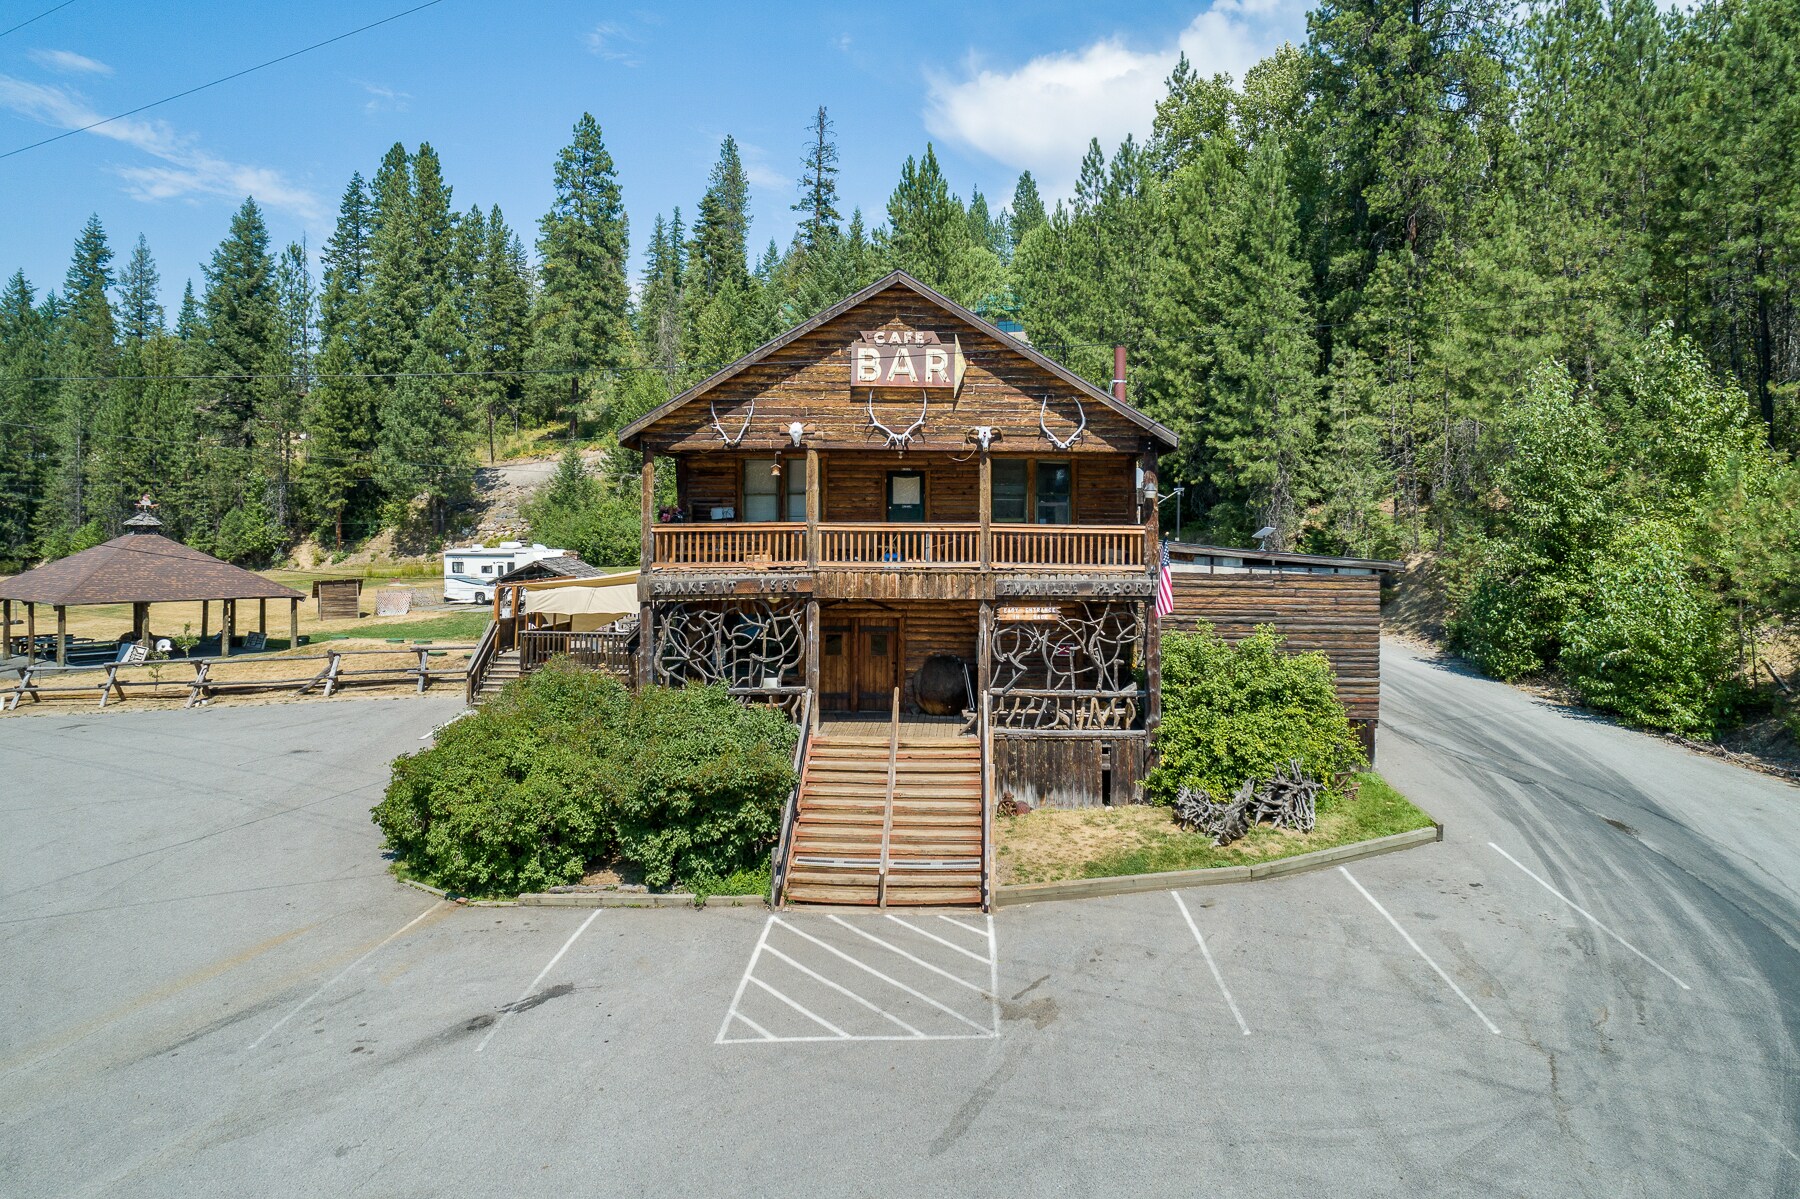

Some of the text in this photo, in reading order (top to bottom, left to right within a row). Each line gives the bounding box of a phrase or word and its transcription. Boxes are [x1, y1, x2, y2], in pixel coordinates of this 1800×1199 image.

[873, 331, 925, 344] CAFE
[857, 347, 951, 383] BAR
[654, 581, 707, 595] SNAKE
